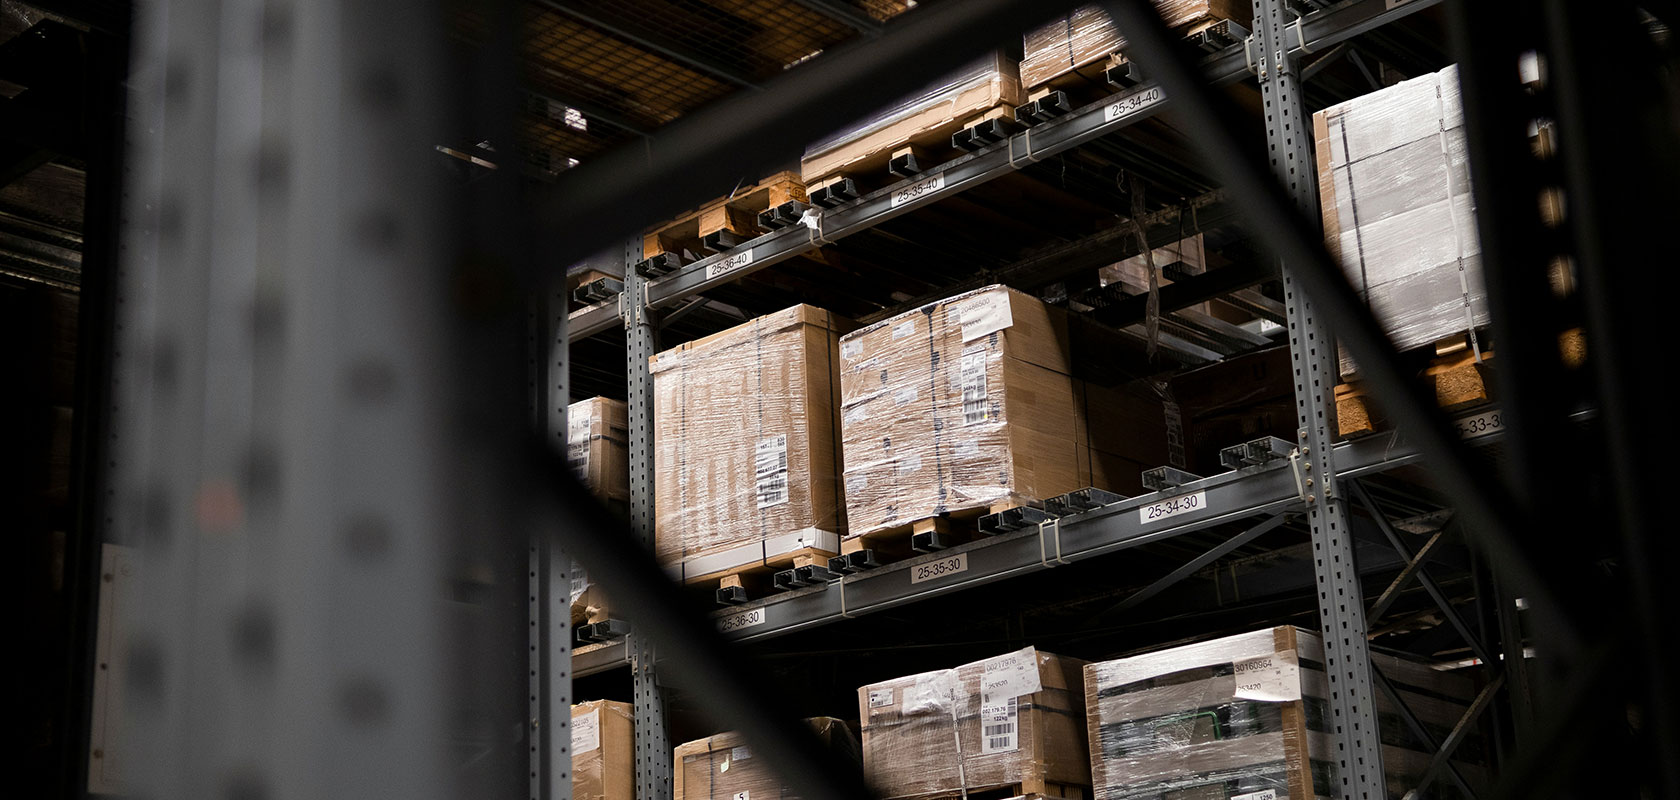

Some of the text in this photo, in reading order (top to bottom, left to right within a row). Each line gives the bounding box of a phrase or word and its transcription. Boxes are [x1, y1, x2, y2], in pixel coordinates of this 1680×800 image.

[1112, 89, 1158, 116] 25-34-40
[898, 178, 937, 202] 25-35-40
[712, 253, 747, 275] 25-36-40
[1456, 414, 1505, 437] 5-33-3
[1148, 495, 1197, 519] 25-34-30
[918, 558, 960, 579] 25-35-30
[721, 611, 759, 631] 25-36-30
[1235, 659, 1272, 673] 30160964
